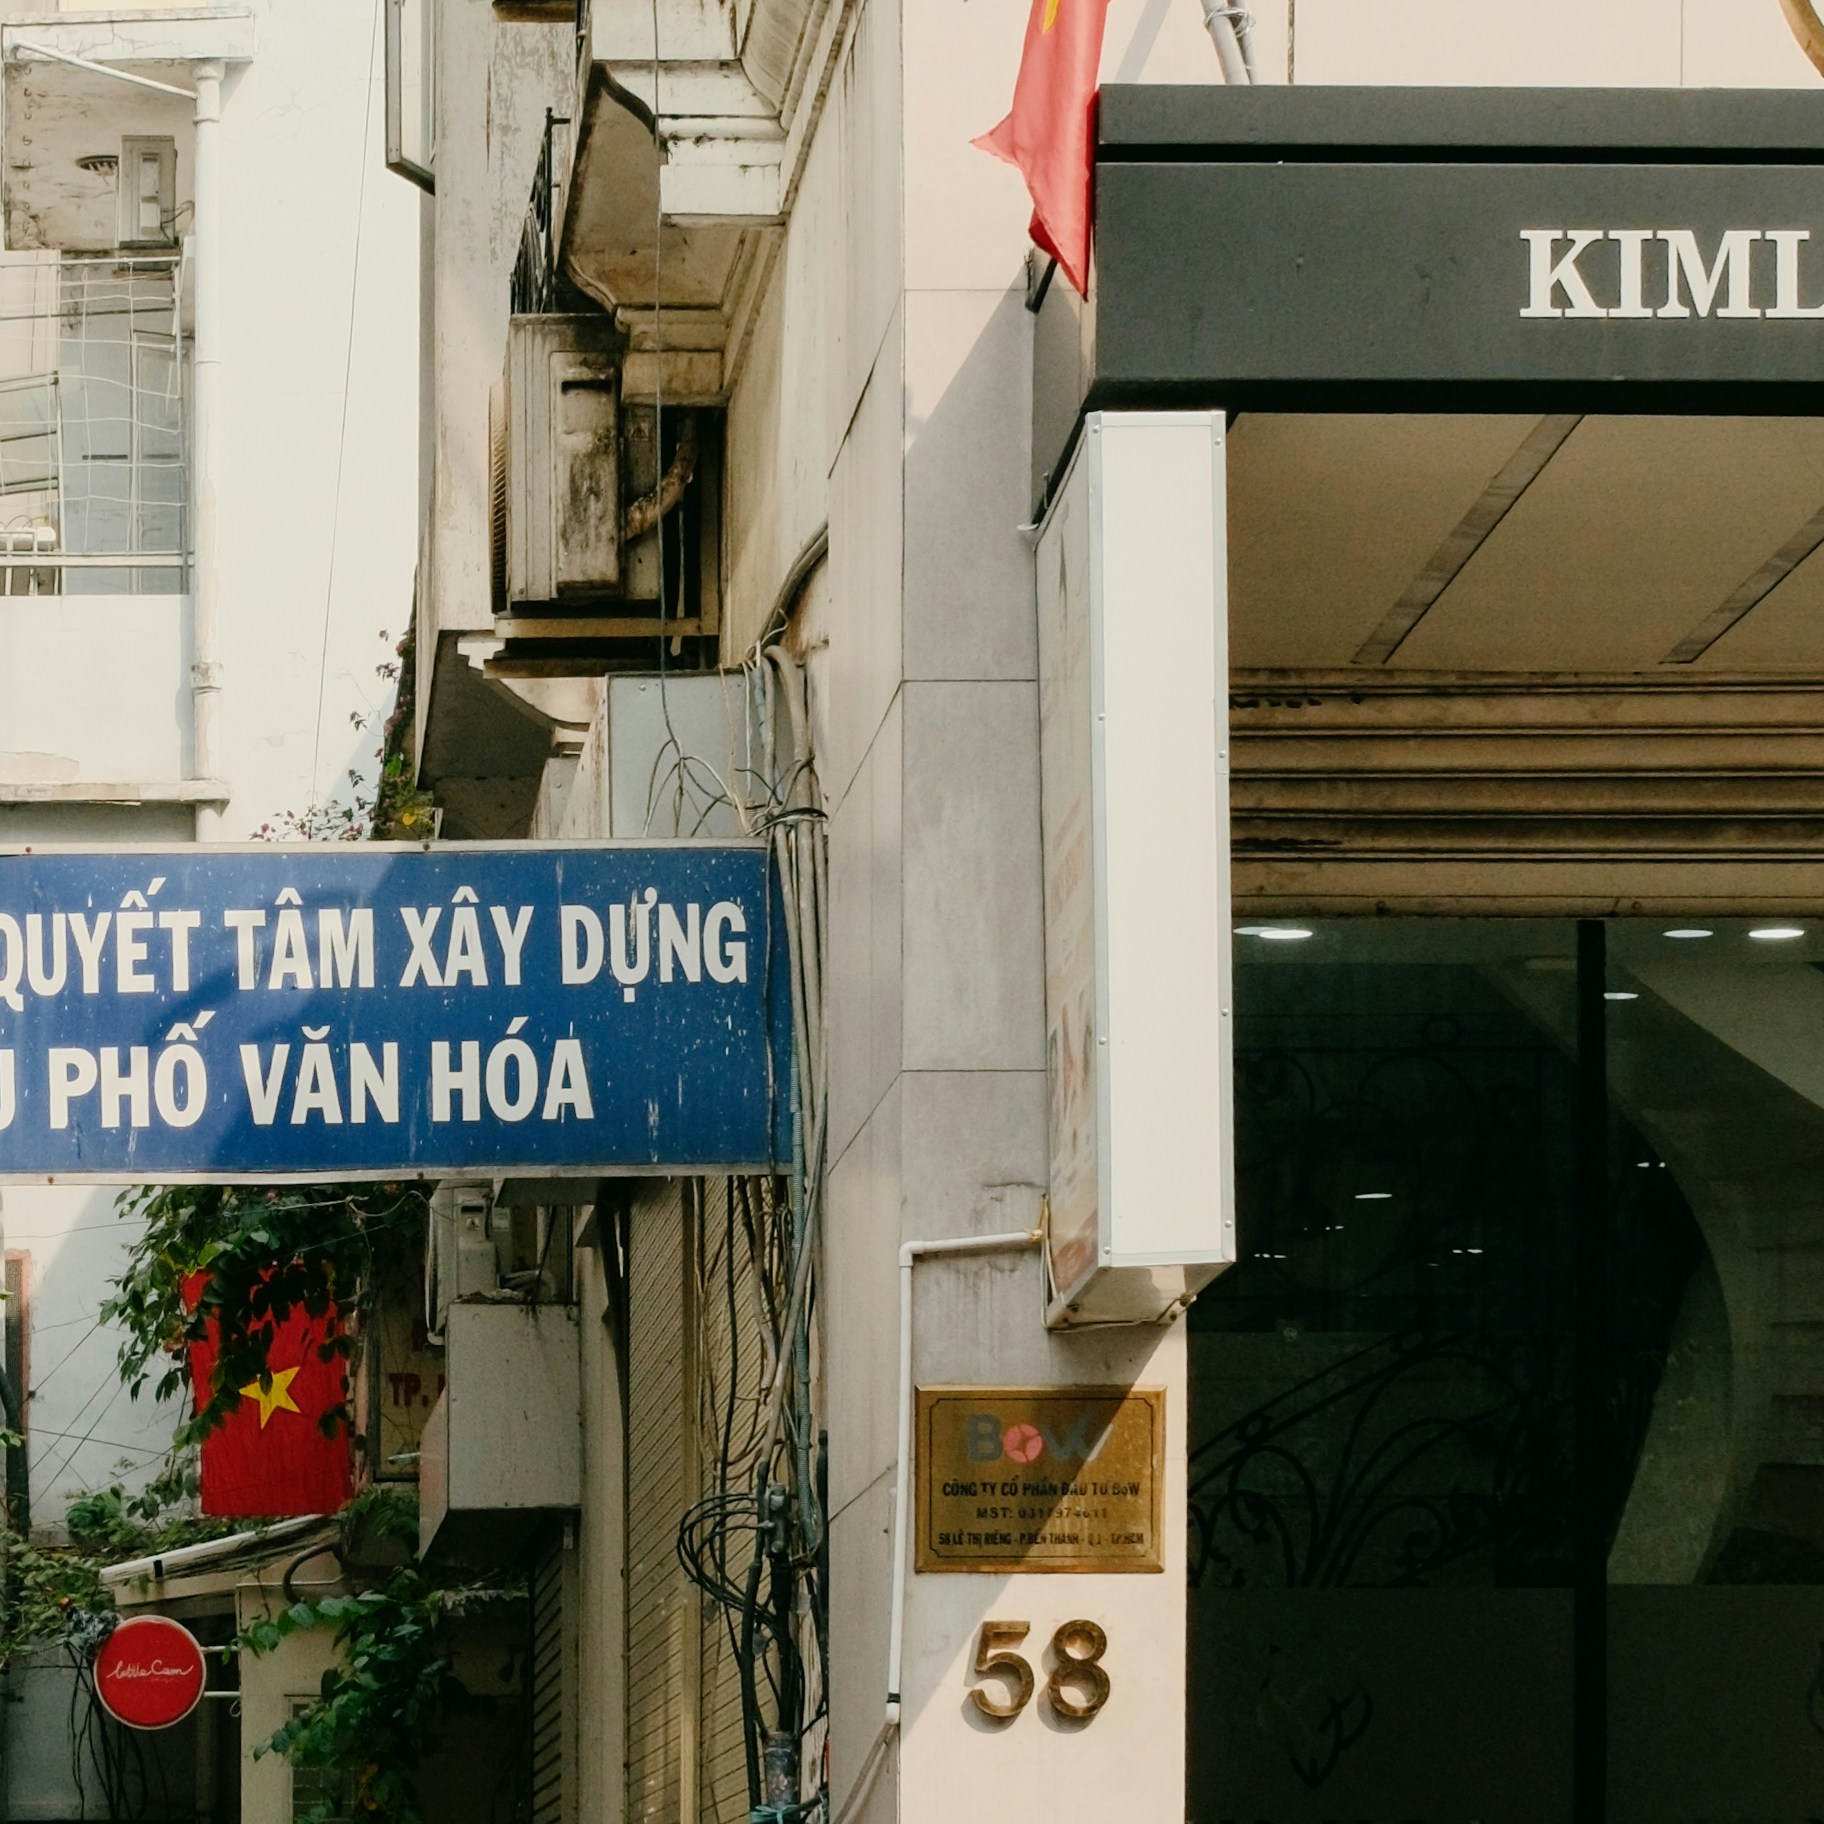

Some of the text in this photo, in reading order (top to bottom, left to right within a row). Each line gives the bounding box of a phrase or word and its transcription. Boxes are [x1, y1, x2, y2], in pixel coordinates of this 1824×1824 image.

[223, 887, 375, 990] TÂM
[399, 885, 533, 988] XÂY
[561, 887, 749, 1004] DỰNG
[48, 1010, 216, 1129] PHỐ
[240, 1025, 401, 1126] VĂN
[431, 1015, 595, 1124] HÓA
[969, 1618, 1111, 1718] 58
